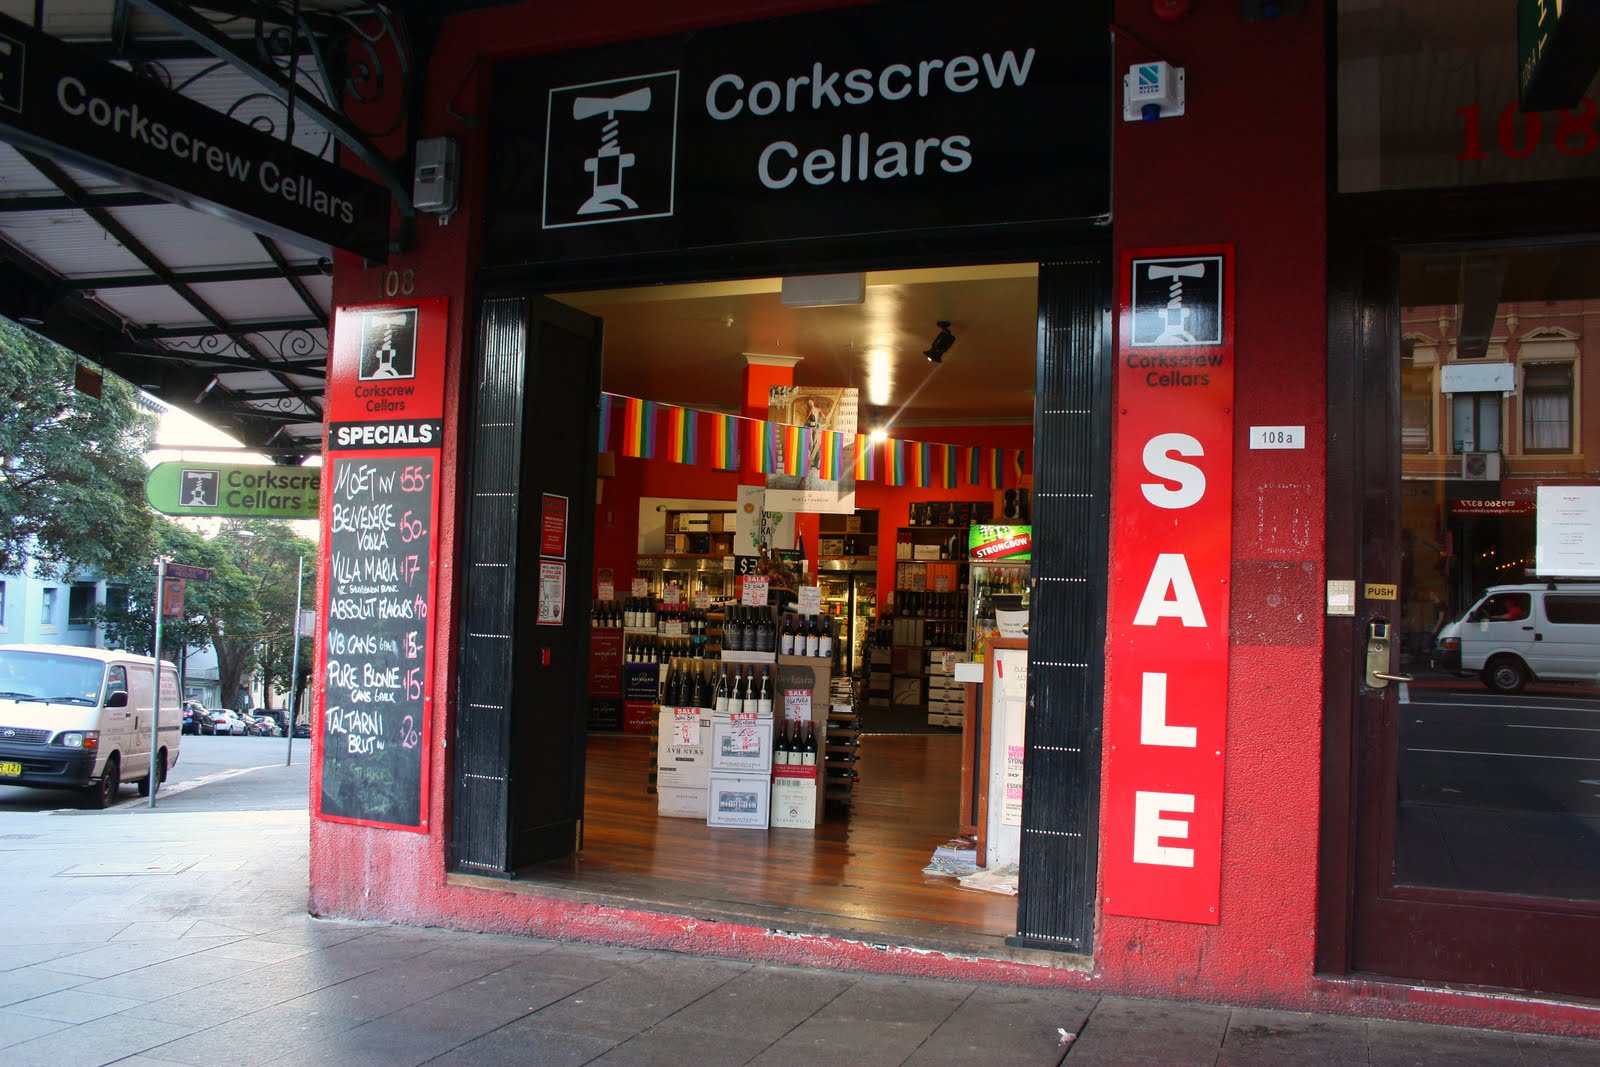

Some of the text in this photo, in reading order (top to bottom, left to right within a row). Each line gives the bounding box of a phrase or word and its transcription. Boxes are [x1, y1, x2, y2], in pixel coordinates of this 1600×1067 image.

[705, 47, 1035, 120] Corkscrew
[1455, 96, 1599, 160] 108
[57, 76, 354, 224] Corkscrew Cellars
[757, 132, 972, 189] Cellars
[378, 269, 415, 297] 108
[1126, 352, 1224, 369] Corkscrew
[1146, 370, 1210, 387] Cellars
[355, 385, 414, 398] Corkscrew
[366, 400, 405, 412] Cellars
[337, 424, 432, 446] SPECIALS
[1261, 432, 1293, 444] 108a
[227, 470, 320, 490] Corkscre
[226, 491, 300, 510] Cellars
[331, 503, 396, 533] BELVEDERE
[976, 537, 1027, 558] STRONGBOW
[332, 551, 361, 584] VILLA
[1367, 587, 1394, 597] PUSH
[328, 629, 345, 654] VB
[348, 634, 377, 655] CANS
[1132, 433, 1207, 868] SALE
[327, 660, 359, 689] PURE
